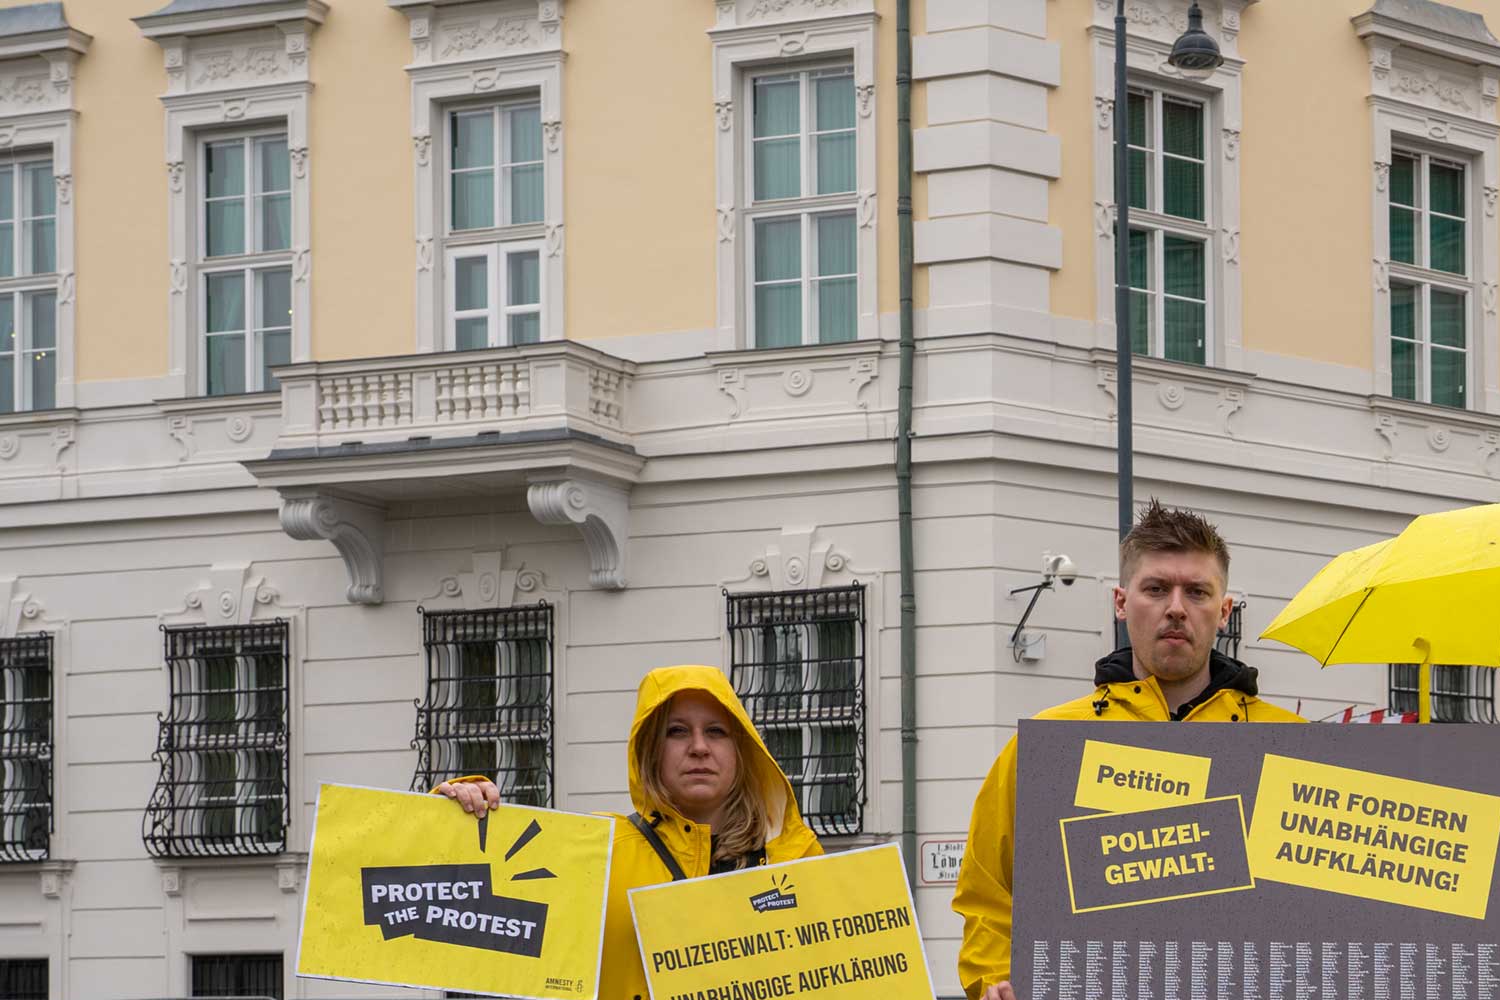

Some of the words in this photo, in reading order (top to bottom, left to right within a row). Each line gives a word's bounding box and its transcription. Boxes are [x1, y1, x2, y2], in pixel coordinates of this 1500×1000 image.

[1096, 765, 1190, 797] Petition
[1292, 783, 1340, 809] WIR
[1347, 794, 1468, 833] FORDERN
[1100, 823, 1211, 855] POLIZEI-
[1280, 811, 1469, 864] UNABHÄNGIGE
[1105, 852, 1215, 885] GEWALT:
[1275, 842, 1459, 893] AUFKLÄRUNG!
[371, 881, 483, 903] PROTECT
[384, 907, 419, 925] THE
[426, 906, 537, 939] PROTEST
[652, 929, 794, 973] POLIZEIGEWALT:
[795, 921, 830, 946] WIR
[832, 906, 911, 938] FORDERN
[546, 977, 573, 986] AMNESTY
[799, 952, 908, 992] AUFKLÄRUNG
